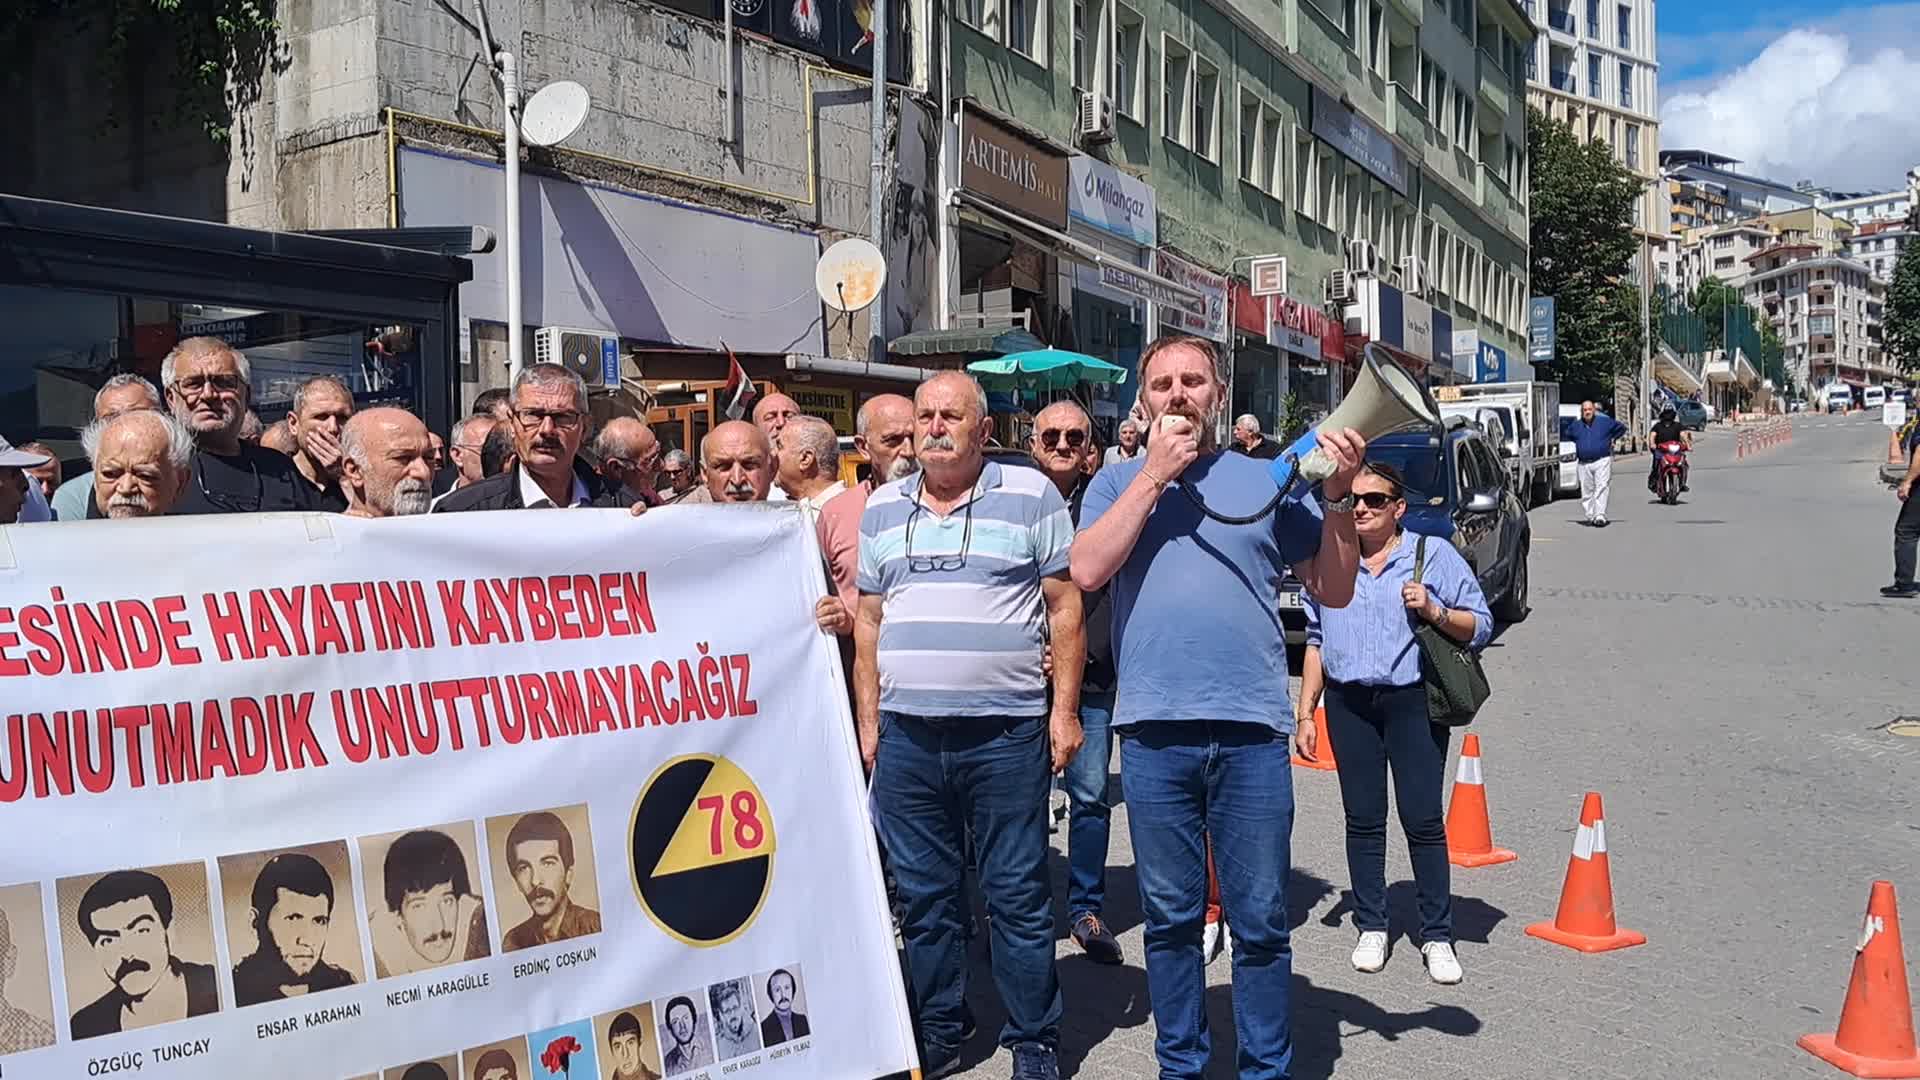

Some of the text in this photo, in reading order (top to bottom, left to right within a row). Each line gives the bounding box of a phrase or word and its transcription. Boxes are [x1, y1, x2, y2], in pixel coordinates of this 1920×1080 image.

[966, 134, 1037, 192] ARTEMİS
[1096, 177, 1146, 221] Milangaz
[202, 579, 436, 662] HAYATINI
[438, 571, 657, 647] KAYBEDEN
[330, 642, 759, 763] UNUTTURMAYACAĞIZ
[697, 789, 765, 856] 78
[513, 946, 598, 979] ERDİNÇ COŞKUN
[386, 972, 490, 1008] NECMİ KARAGÜLLE
[256, 1003, 362, 1040] ENSAR KARAHAN
[87, 1038, 212, 1077] ÖZGÜÇ TUNCAY
